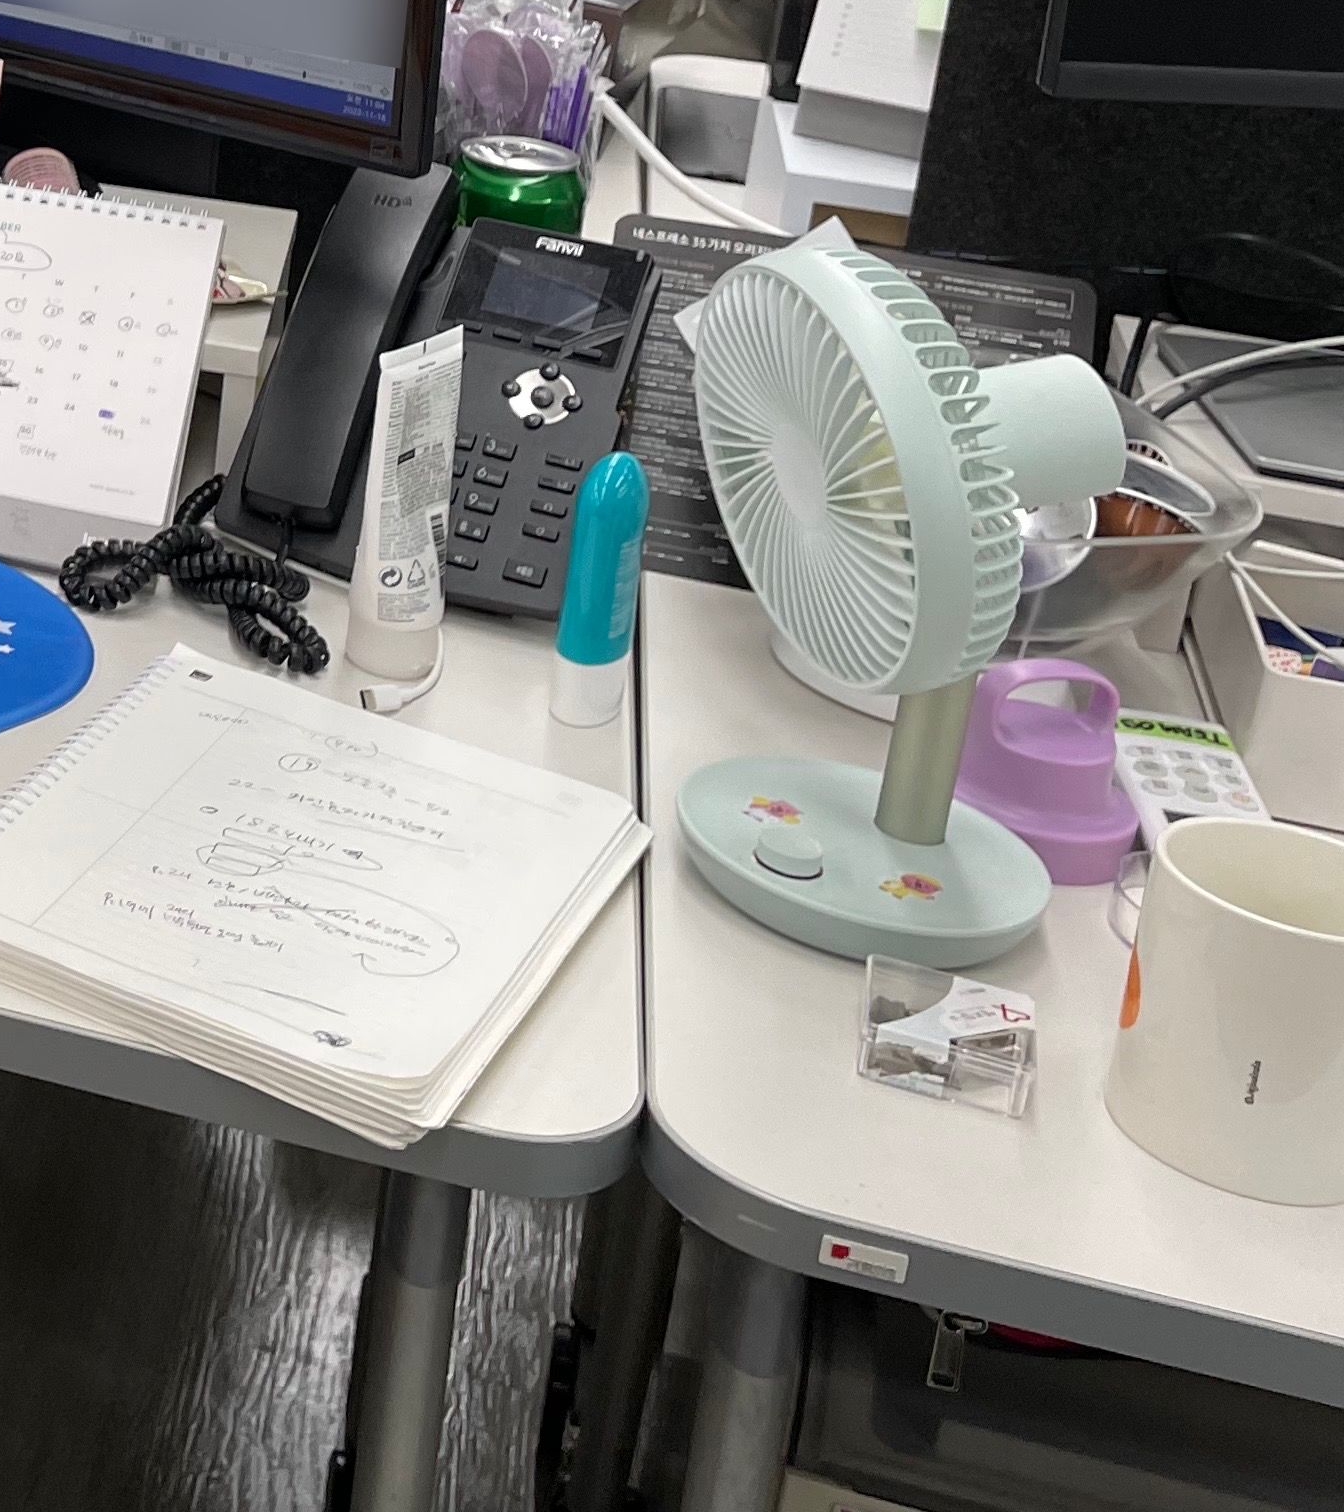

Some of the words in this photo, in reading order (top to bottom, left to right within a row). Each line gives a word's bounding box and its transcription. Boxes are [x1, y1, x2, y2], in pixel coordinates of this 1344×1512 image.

[374, 193, 401, 208] HD
[632, 227, 689, 247] 네스프레소
[535, 235, 585, 257] Fanvil
[476, 466, 487, 479] 6
[468, 492, 479, 505] 9
